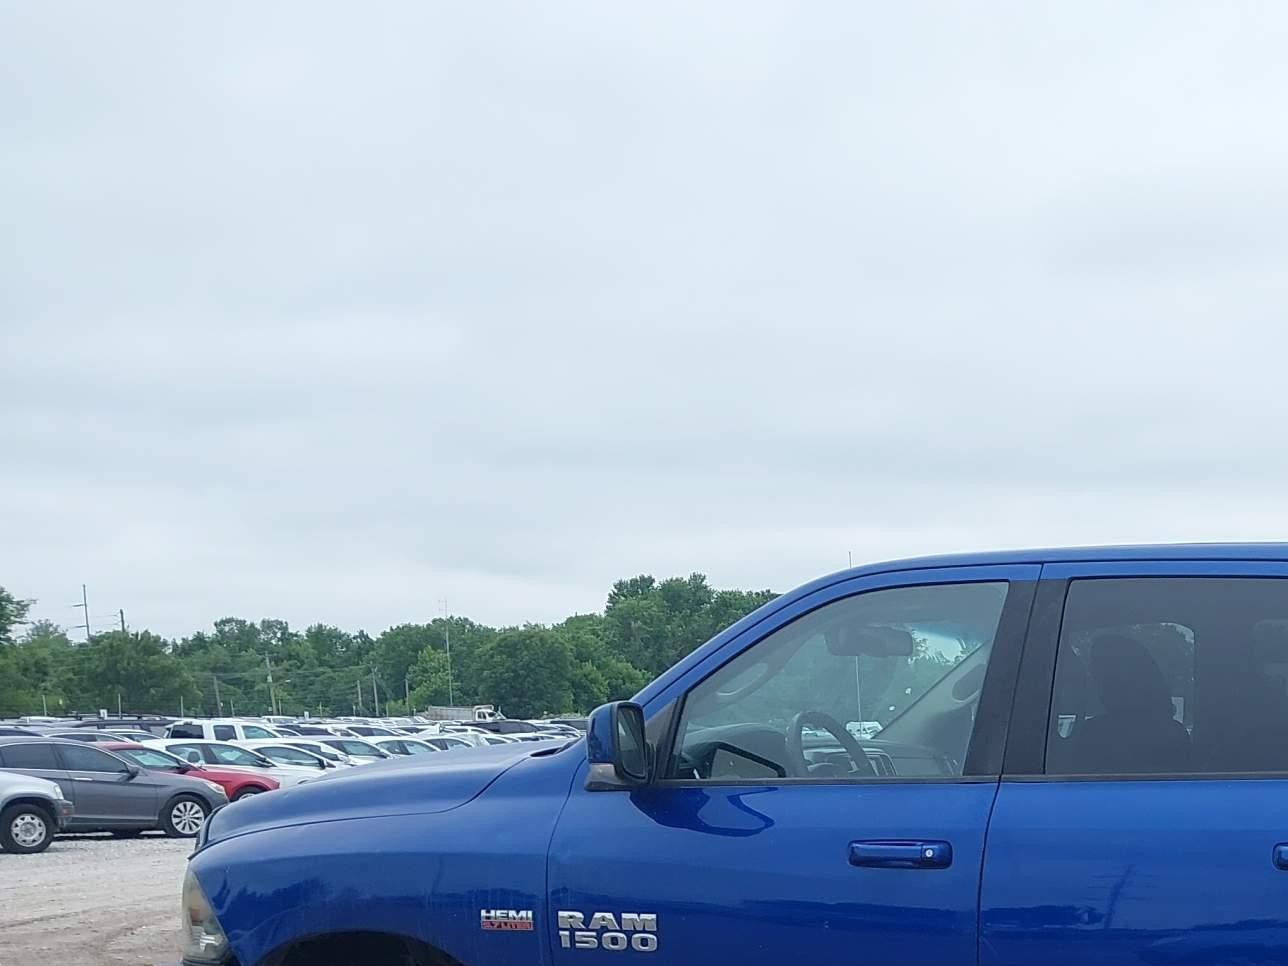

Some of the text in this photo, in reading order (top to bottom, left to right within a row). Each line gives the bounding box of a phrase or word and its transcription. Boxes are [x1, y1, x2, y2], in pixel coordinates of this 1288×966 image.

[480, 909, 533, 921] HEMI
[557, 910, 657, 932] RAM
[558, 930, 658, 952] 1500
